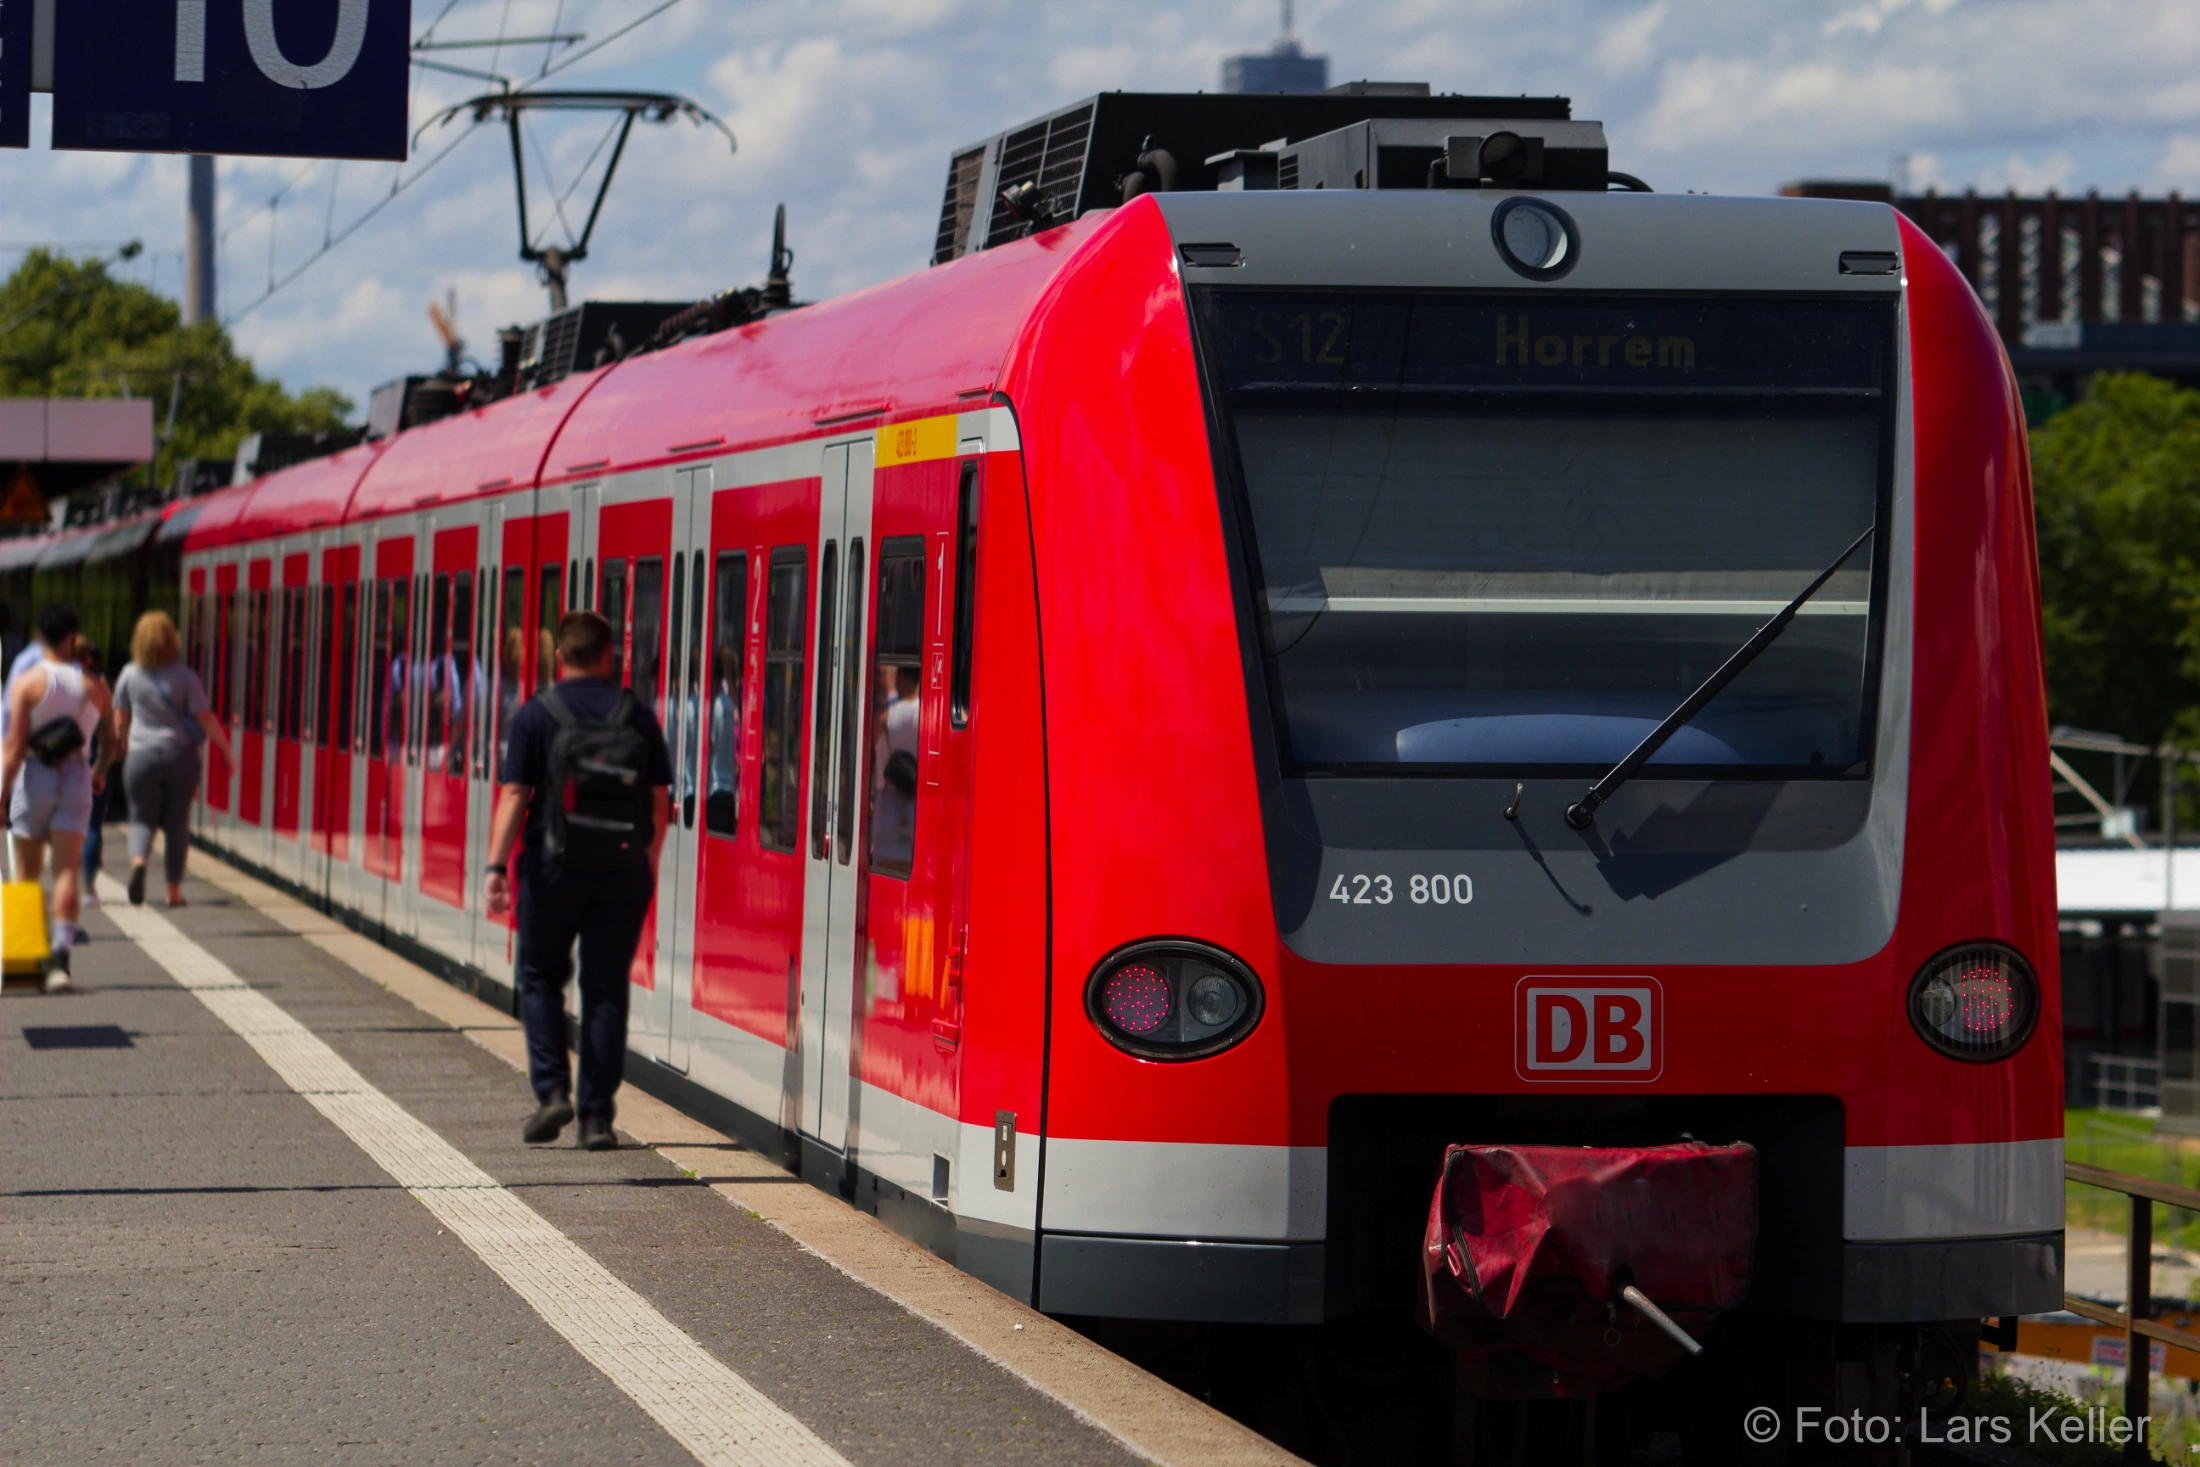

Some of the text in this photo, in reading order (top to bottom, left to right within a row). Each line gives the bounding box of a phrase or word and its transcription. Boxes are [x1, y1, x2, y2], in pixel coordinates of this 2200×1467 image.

[1253, 310, 1696, 368] S12 Horrem
[751, 554, 762, 634] 2
[937, 541, 945, 636] 1
[1329, 874, 1473, 904] 423 800
[1535, 994, 1645, 1064] DB
